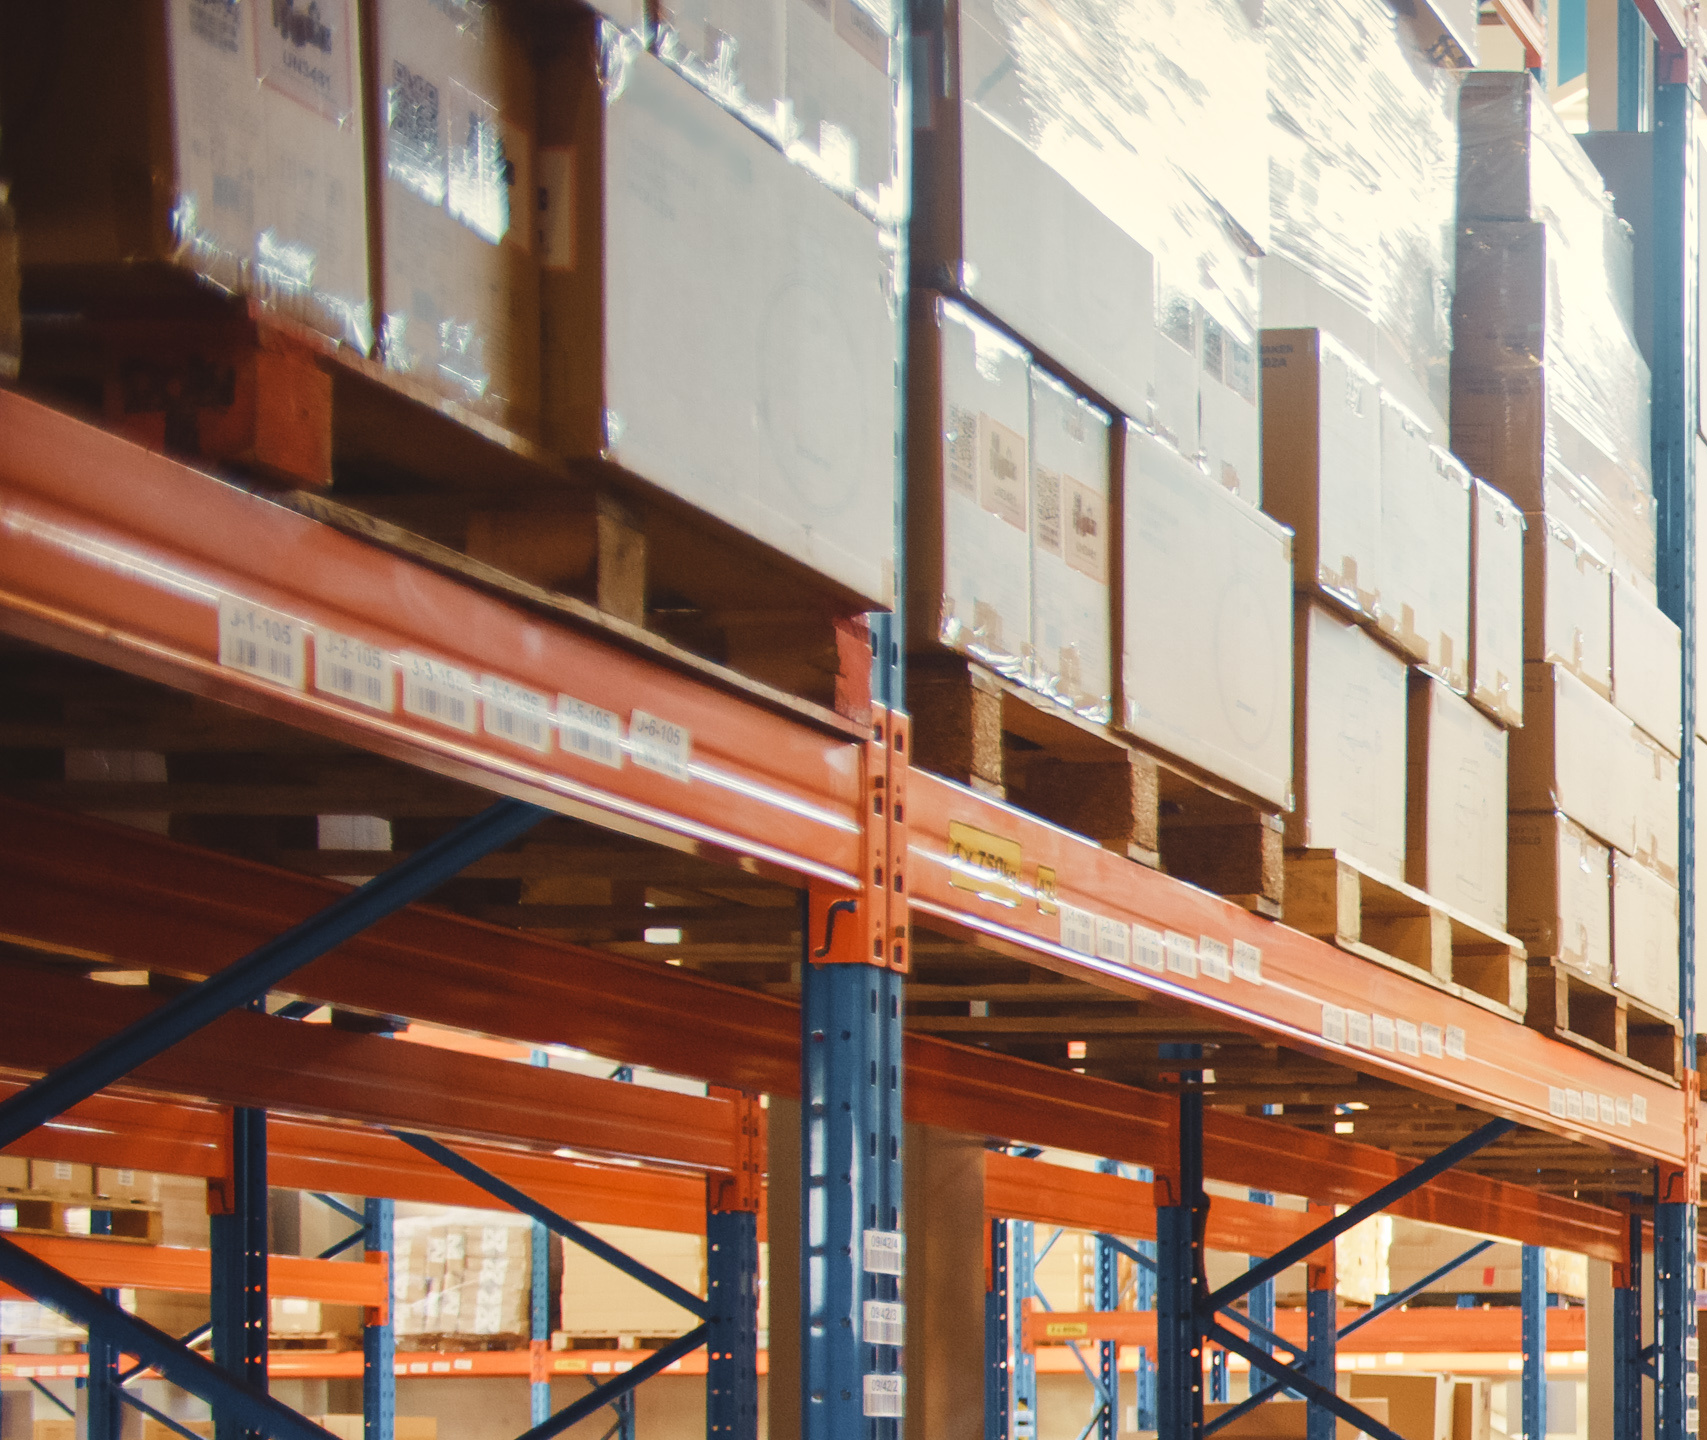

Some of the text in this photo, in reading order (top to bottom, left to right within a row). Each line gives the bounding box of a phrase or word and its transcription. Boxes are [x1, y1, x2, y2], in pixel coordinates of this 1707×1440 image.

[230, 609, 292, 646] J-1-105
[326, 633, 383, 671] J-2-105
[564, 698, 611, 731] J-5-105
[637, 718, 681, 747] J-6-105
